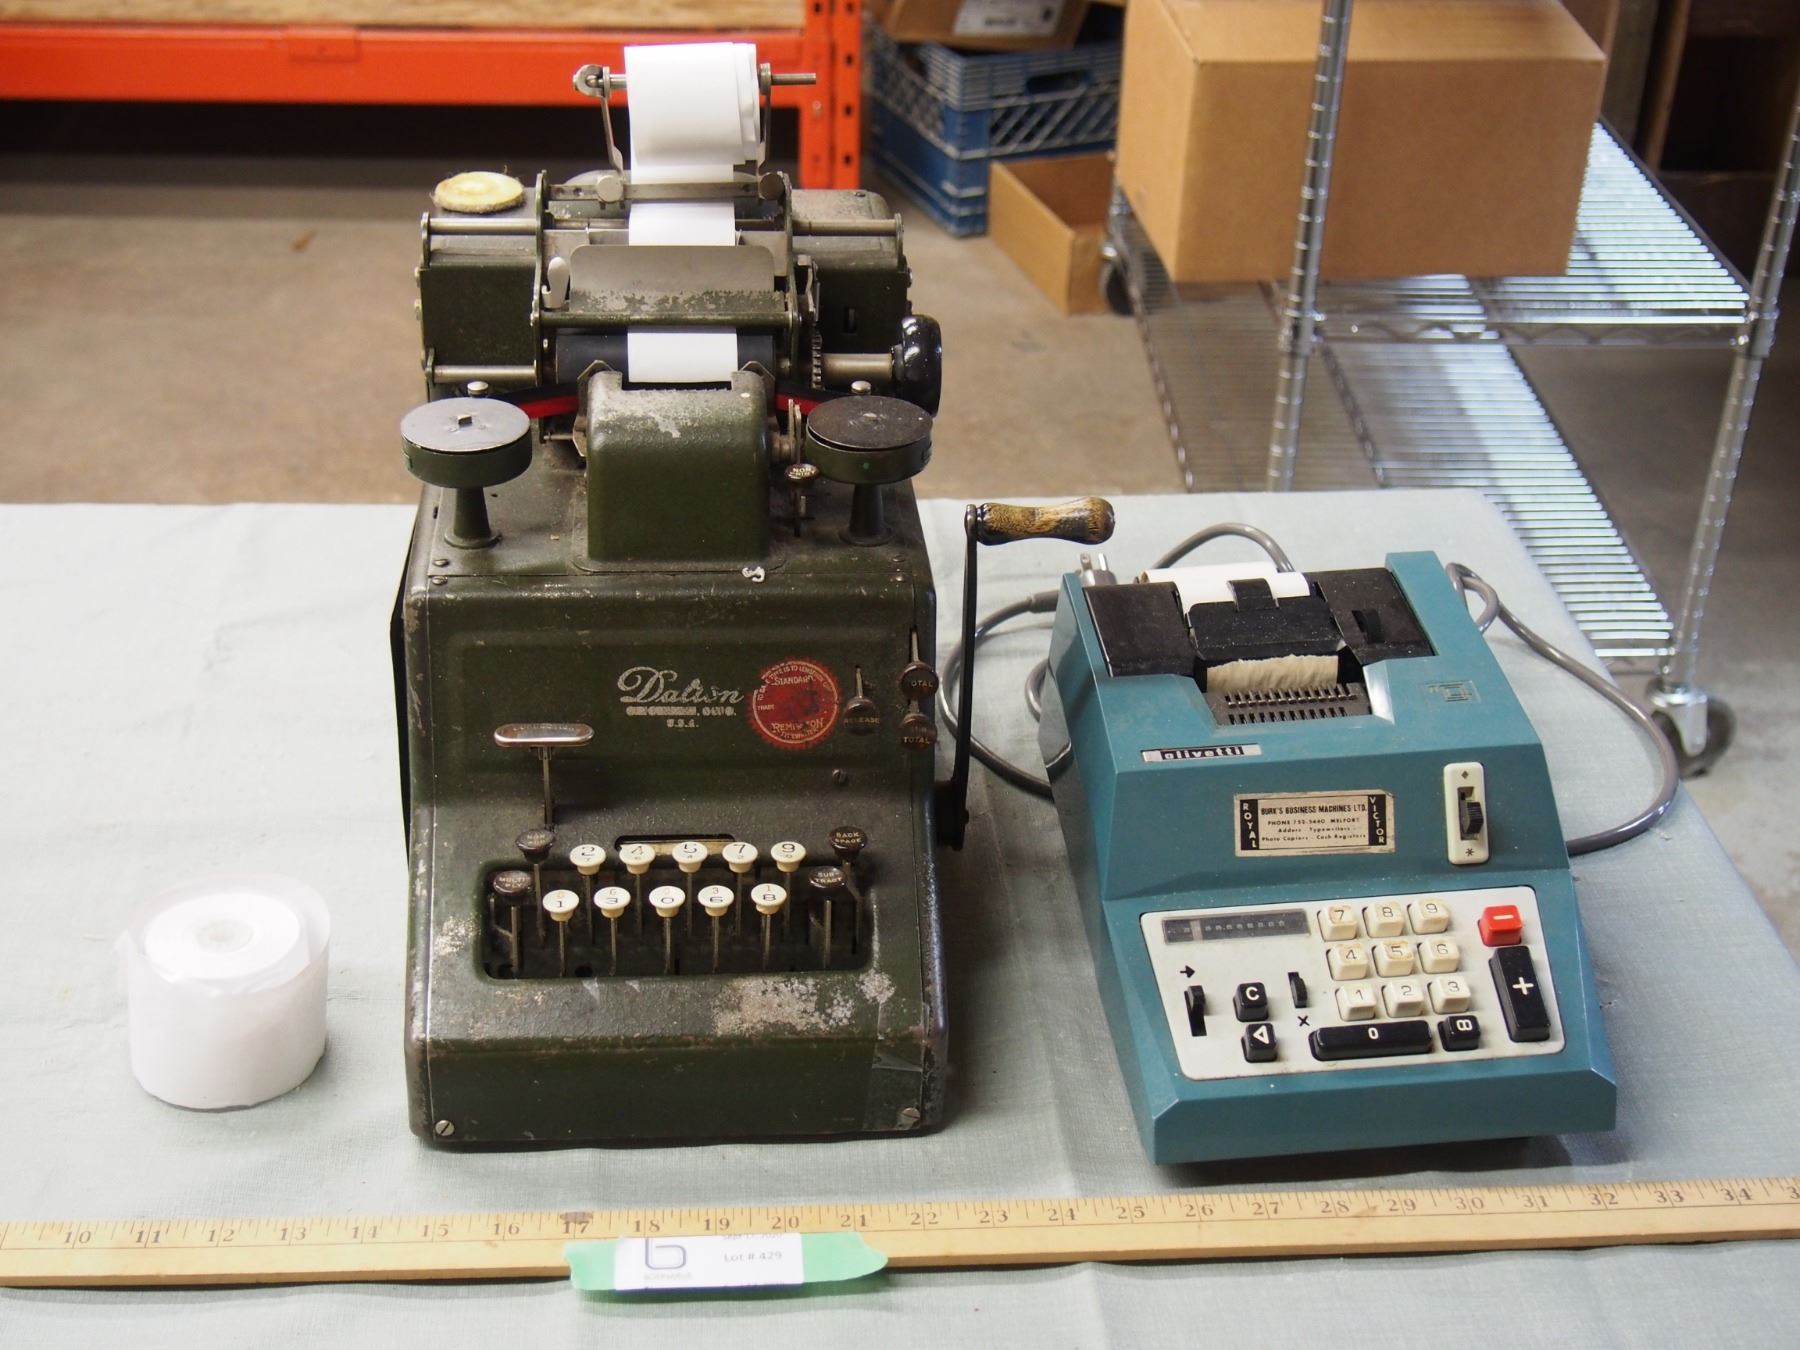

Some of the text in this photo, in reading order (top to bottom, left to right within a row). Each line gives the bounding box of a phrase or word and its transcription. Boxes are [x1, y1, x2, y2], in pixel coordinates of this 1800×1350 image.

[617, 666, 744, 703] Dalton
[1164, 746, 1241, 760] olivetti
[1261, 807, 1284, 816] BURK'S
[1285, 806, 1317, 815] BUSINESS
[1318, 805, 1351, 814] MACHINES
[1242, 803, 1257, 848] ROYAL
[1369, 797, 1385, 843] VICTOR
[733, 843, 746, 854] 7
[781, 843, 795, 853] 9
[557, 900, 563, 908] 1
[606, 897, 618, 905] 3
[1382, 906, 1394, 918] 8
[1425, 903, 1438, 914] 9
[1334, 909, 1345, 921] 7
[1345, 949, 1357, 961] 4
[1390, 945, 1403, 956] 5
[1436, 943, 1449, 955] 6
[1400, 985, 1414, 996] 2
[1447, 981, 1460, 992] 3
[1245, 986, 1259, 1001] C
[1355, 989, 1364, 1001] 1
[1367, 1027, 1379, 1040] 0
[65, 1230, 91, 1244] 10
[136, 1230, 161, 1244] 11
[208, 1228, 235, 1243] 12
[281, 1227, 307, 1241] 13
[353, 1226, 378, 1239] 14
[421, 1223, 449, 1238] 15
[493, 1222, 520, 1236] 16
[562, 1220, 590, 1234] 17
[633, 1218, 661, 1233] 18
[703, 1217, 730, 1231] 19
[771, 1215, 800, 1230] 20
[841, 1214, 868, 1227] 21
[910, 1211, 940, 1225] 22
[979, 1209, 1009, 1224] 23
[1047, 1208, 1078, 1222] 24
[1115, 1205, 1146, 1220] 25
[1184, 1203, 1214, 1218] 26
[1252, 1201, 1281, 1216] 27
[1320, 1199, 1350, 1214] 28
[1387, 1197, 1417, 1212] 29
[1455, 1196, 1485, 1211] 30
[1522, 1194, 1549, 1209] 31
[1590, 1192, 1618, 1206] 32
[1654, 1189, 1684, 1204] 33
[1720, 1188, 1753, 1201] 34
[724, 1252, 744, 1262] Lot
[759, 1251, 782, 1260] 429
